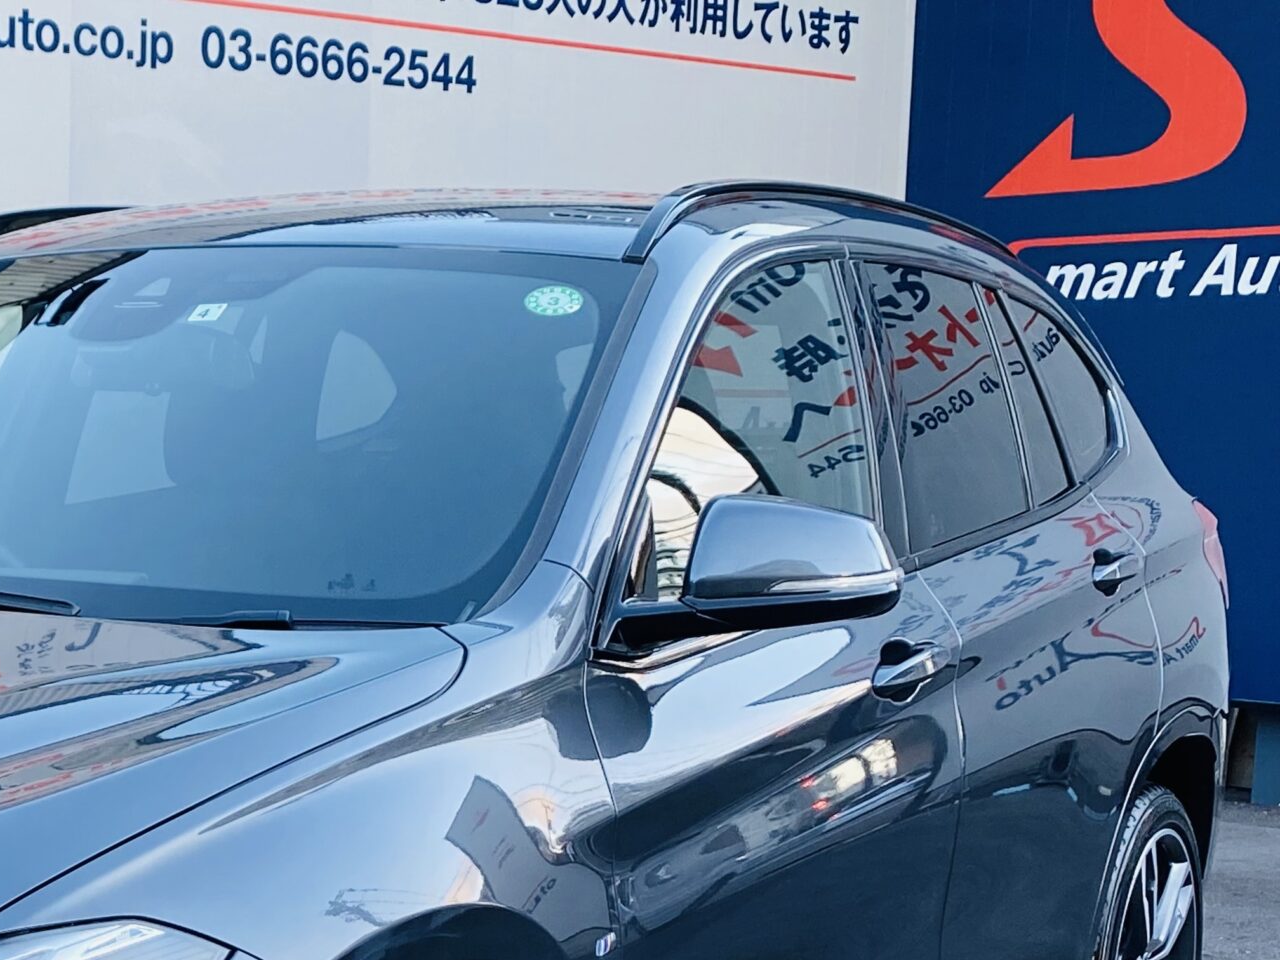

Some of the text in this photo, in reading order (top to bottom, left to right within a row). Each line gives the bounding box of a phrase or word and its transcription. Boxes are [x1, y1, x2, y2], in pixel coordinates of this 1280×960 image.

[201, 25, 477, 93] 03-6666-2544
[1010, 241, 1280, 301] mart Au
